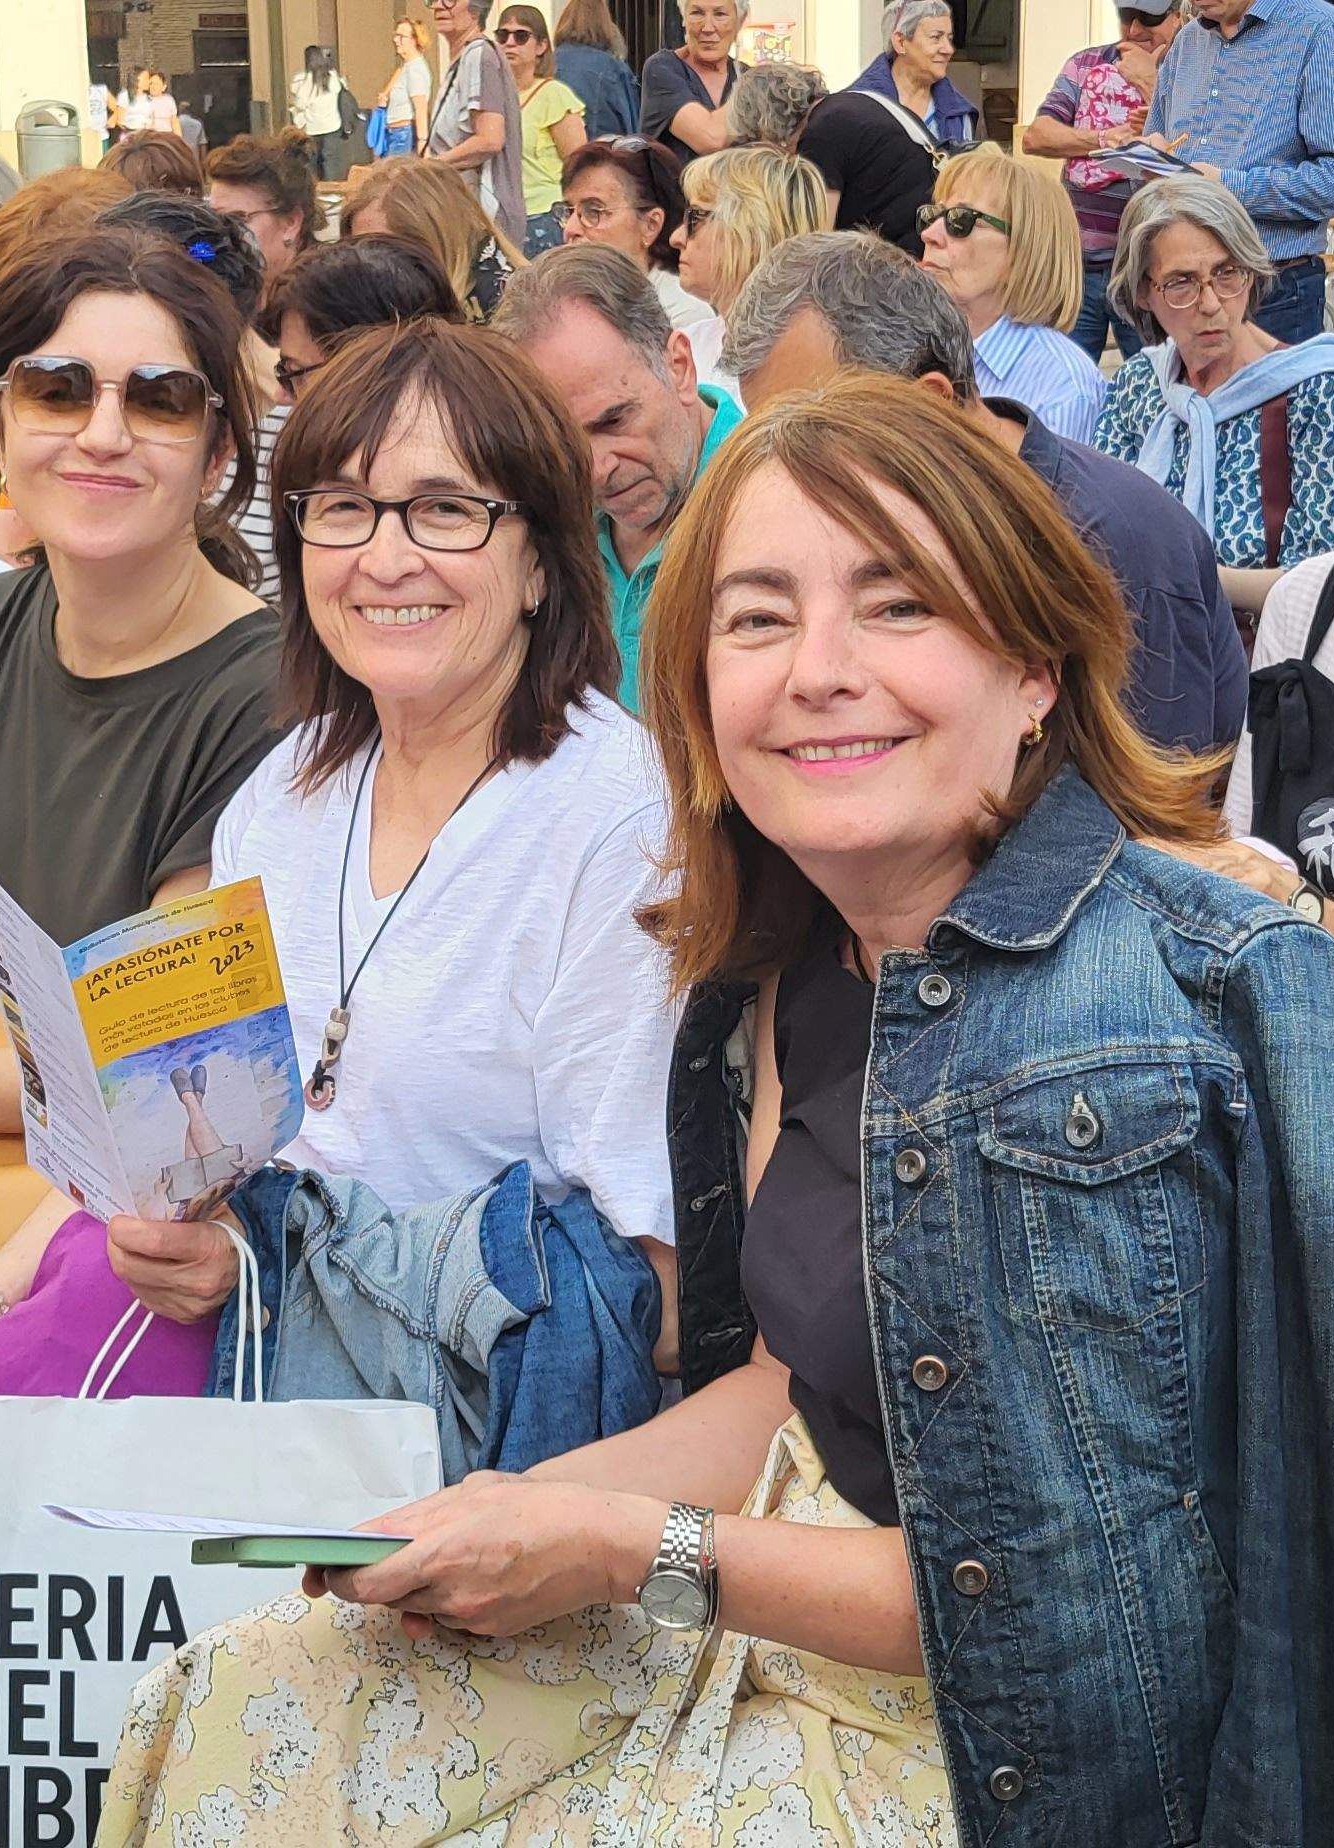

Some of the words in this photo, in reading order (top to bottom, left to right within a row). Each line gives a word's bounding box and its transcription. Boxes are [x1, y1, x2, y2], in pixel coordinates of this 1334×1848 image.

[170, 908, 183, 917] de
[184, 898, 214, 912] Huesca
[85, 934, 203, 990] ¡APASIÓNATE
[208, 922, 245, 942] POR
[89, 986, 111, 1002] LA
[115, 953, 196, 990] LECTURA!
[210, 939, 254, 976] 2023
[128, 1012, 174, 1032] votados
[177, 1006, 192, 1016] en
[195, 1001, 210, 1011] los
[213, 988, 250, 1005] clubes
[129, 1011, 144, 1022] de
[148, 997, 189, 1015] lectura
[191, 990, 207, 1001] de
[210, 985, 225, 995] los
[228, 975, 257, 991] libros
[104, 1043, 119, 1053] de
[122, 1026, 162, 1044] lectura
[165, 1020, 181, 1031] de
[184, 1005, 227, 1024] Huesca
